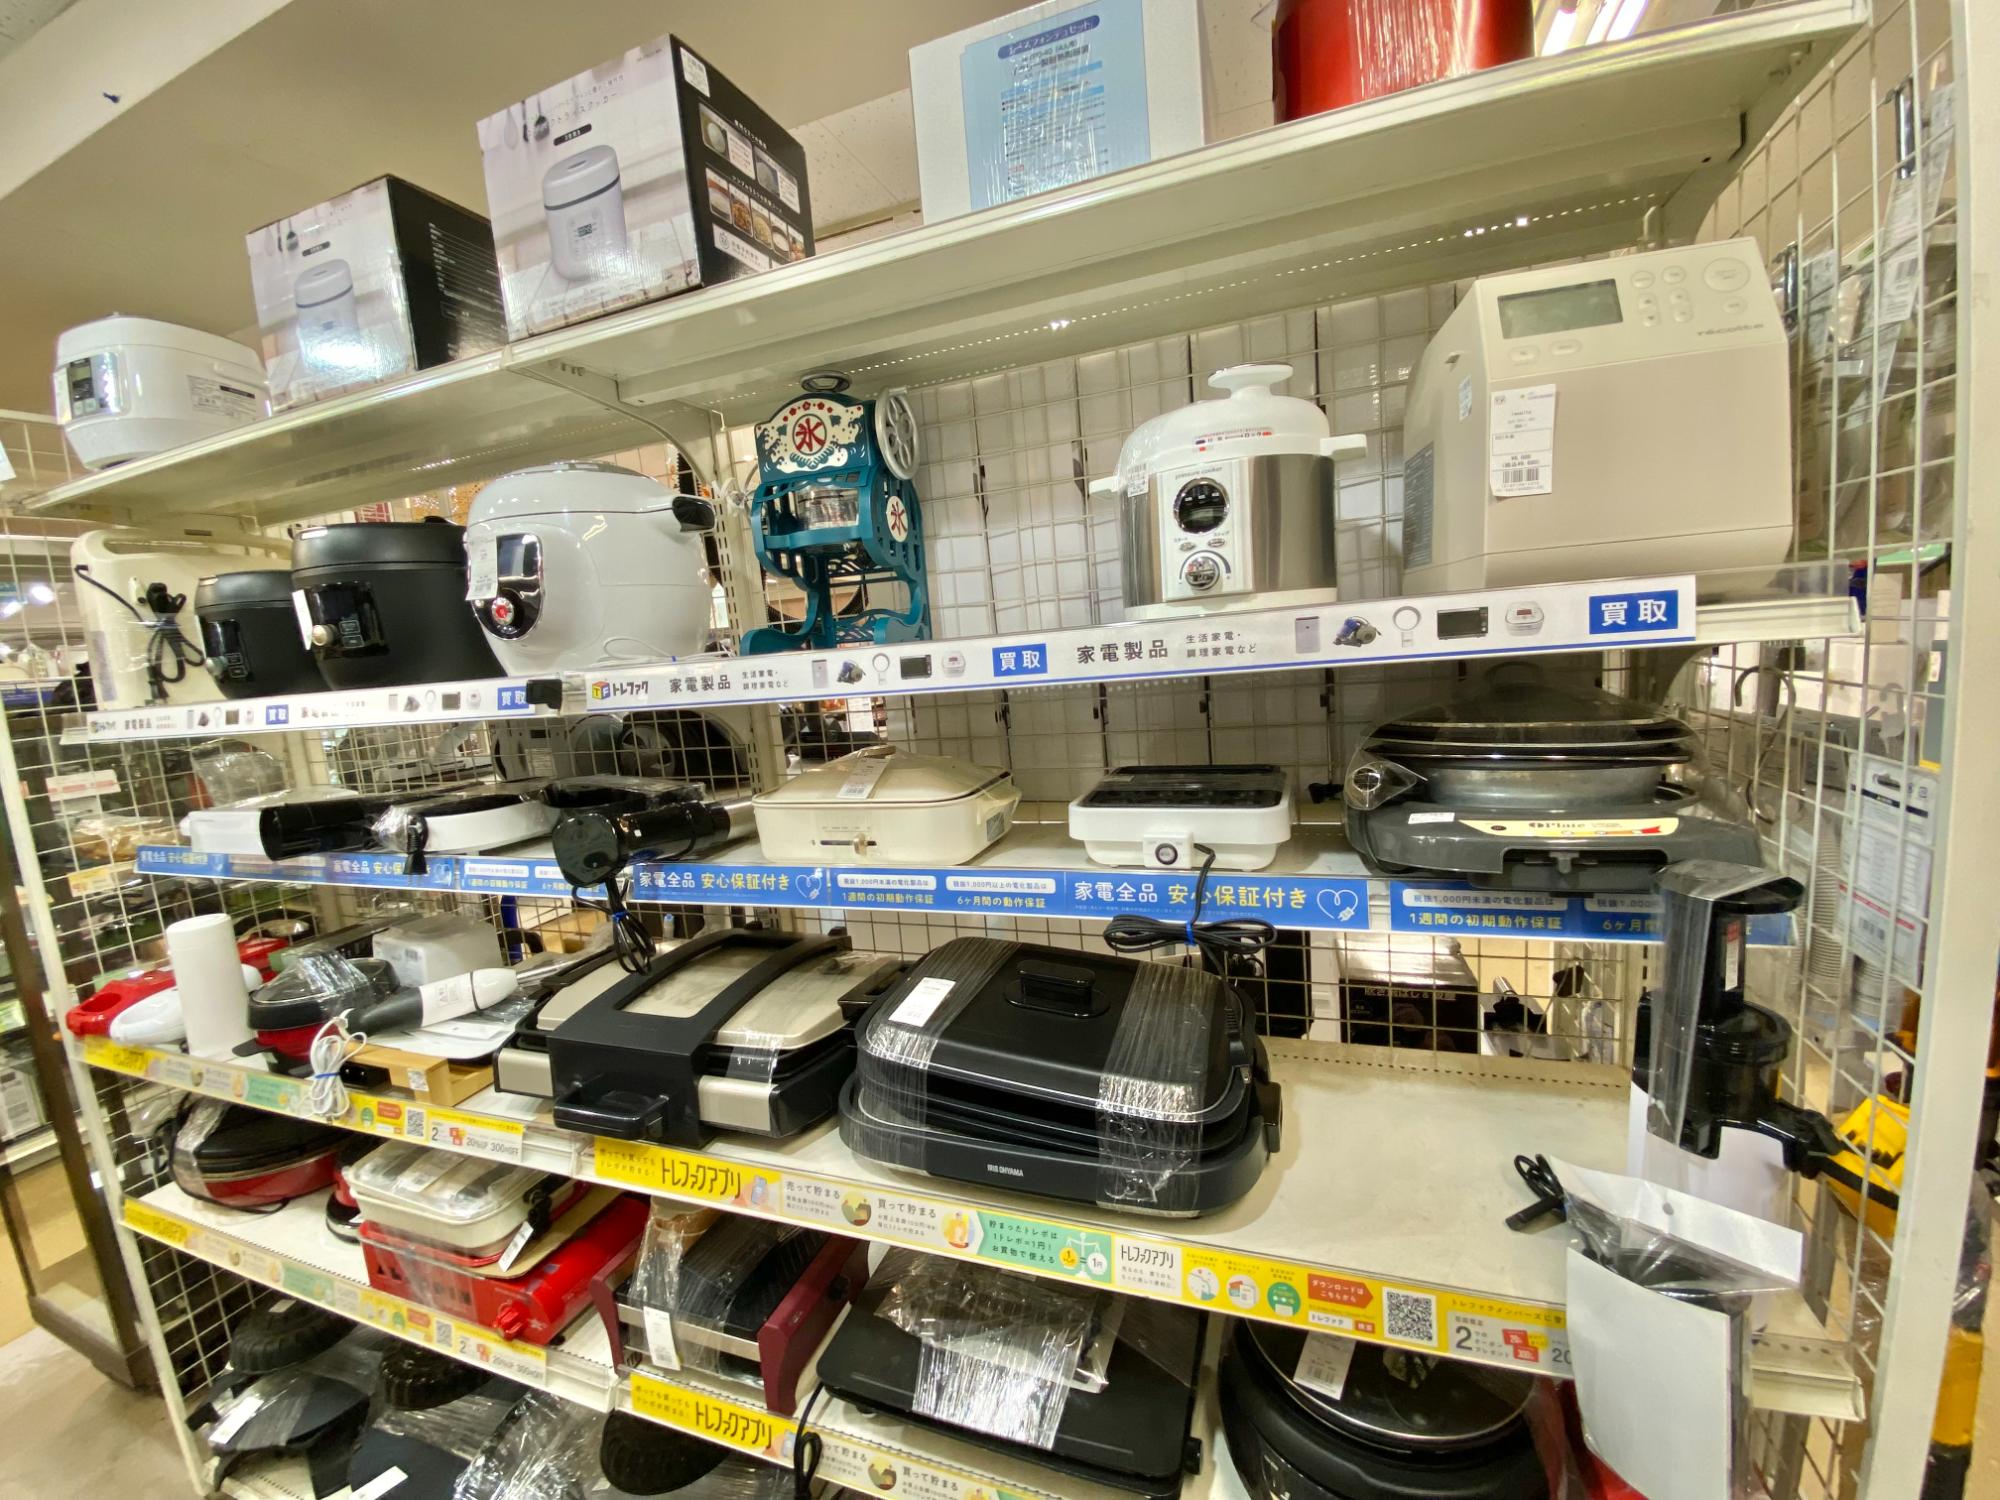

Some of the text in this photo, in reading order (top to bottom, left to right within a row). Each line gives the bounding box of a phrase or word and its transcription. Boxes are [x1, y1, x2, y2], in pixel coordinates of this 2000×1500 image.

[795, 417, 826, 452] 氷
[890, 500, 908, 536] 氷
[1601, 598, 1668, 627] 買取
[999, 649, 1041, 671] 買取
[1076, 639, 1169, 664] 家電製品
[1186, 644, 1257, 658] 調理家電など
[612, 681, 649, 696] トレファク
[669, 674, 732, 693] 家電製品
[501, 691, 526, 706] 買取
[639, 872, 791, 891] 家電全品 安心保証付き
[1074, 881, 1308, 909] 家電全品 安心保証付き
[1409, 912, 1563, 930] 1週間の初期動作保証
[661, 1156, 742, 1199] トレファクアプリ
[877, 1198, 937, 1219] 買って貯まる
[988, 1219, 1059, 1240] 貯まったトレポは
[992, 1244, 1056, 1264] お買物で使える
[1120, 1244, 1175, 1269] トレファクアプリ
[1311, 1278, 1364, 1296] ダウンロードは
[1320, 1289, 1357, 1303] こちらから
[1310, 1313, 1344, 1326] トレファク
[1455, 1325, 1473, 1351] 2
[695, 1400, 772, 1449] トレファクアプリ
[822, 1444, 868, 1464] って貯まる
[902, 1464, 959, 1492] 買って貯まる
